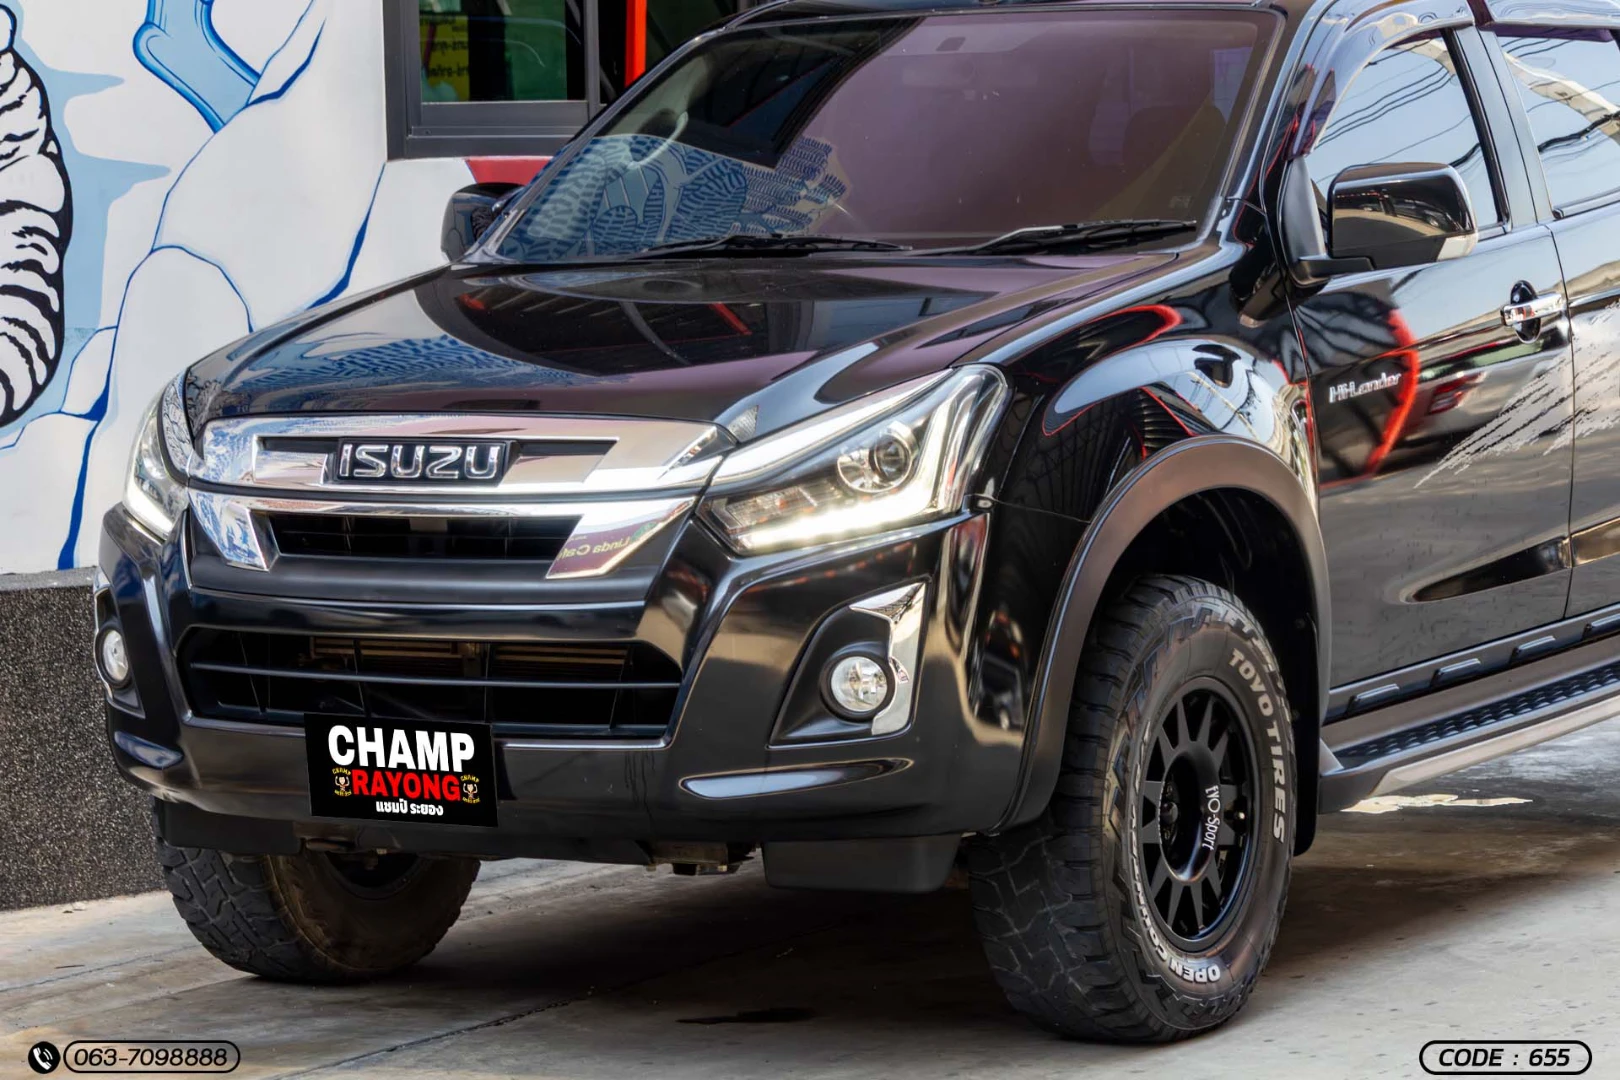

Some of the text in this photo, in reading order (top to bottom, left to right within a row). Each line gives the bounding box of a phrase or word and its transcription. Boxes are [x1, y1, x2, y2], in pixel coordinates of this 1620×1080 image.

[339, 444, 501, 479] ISUZU
[1228, 649, 1287, 844] TOYO TIRES
[1169, 957, 1221, 983] OPEN
